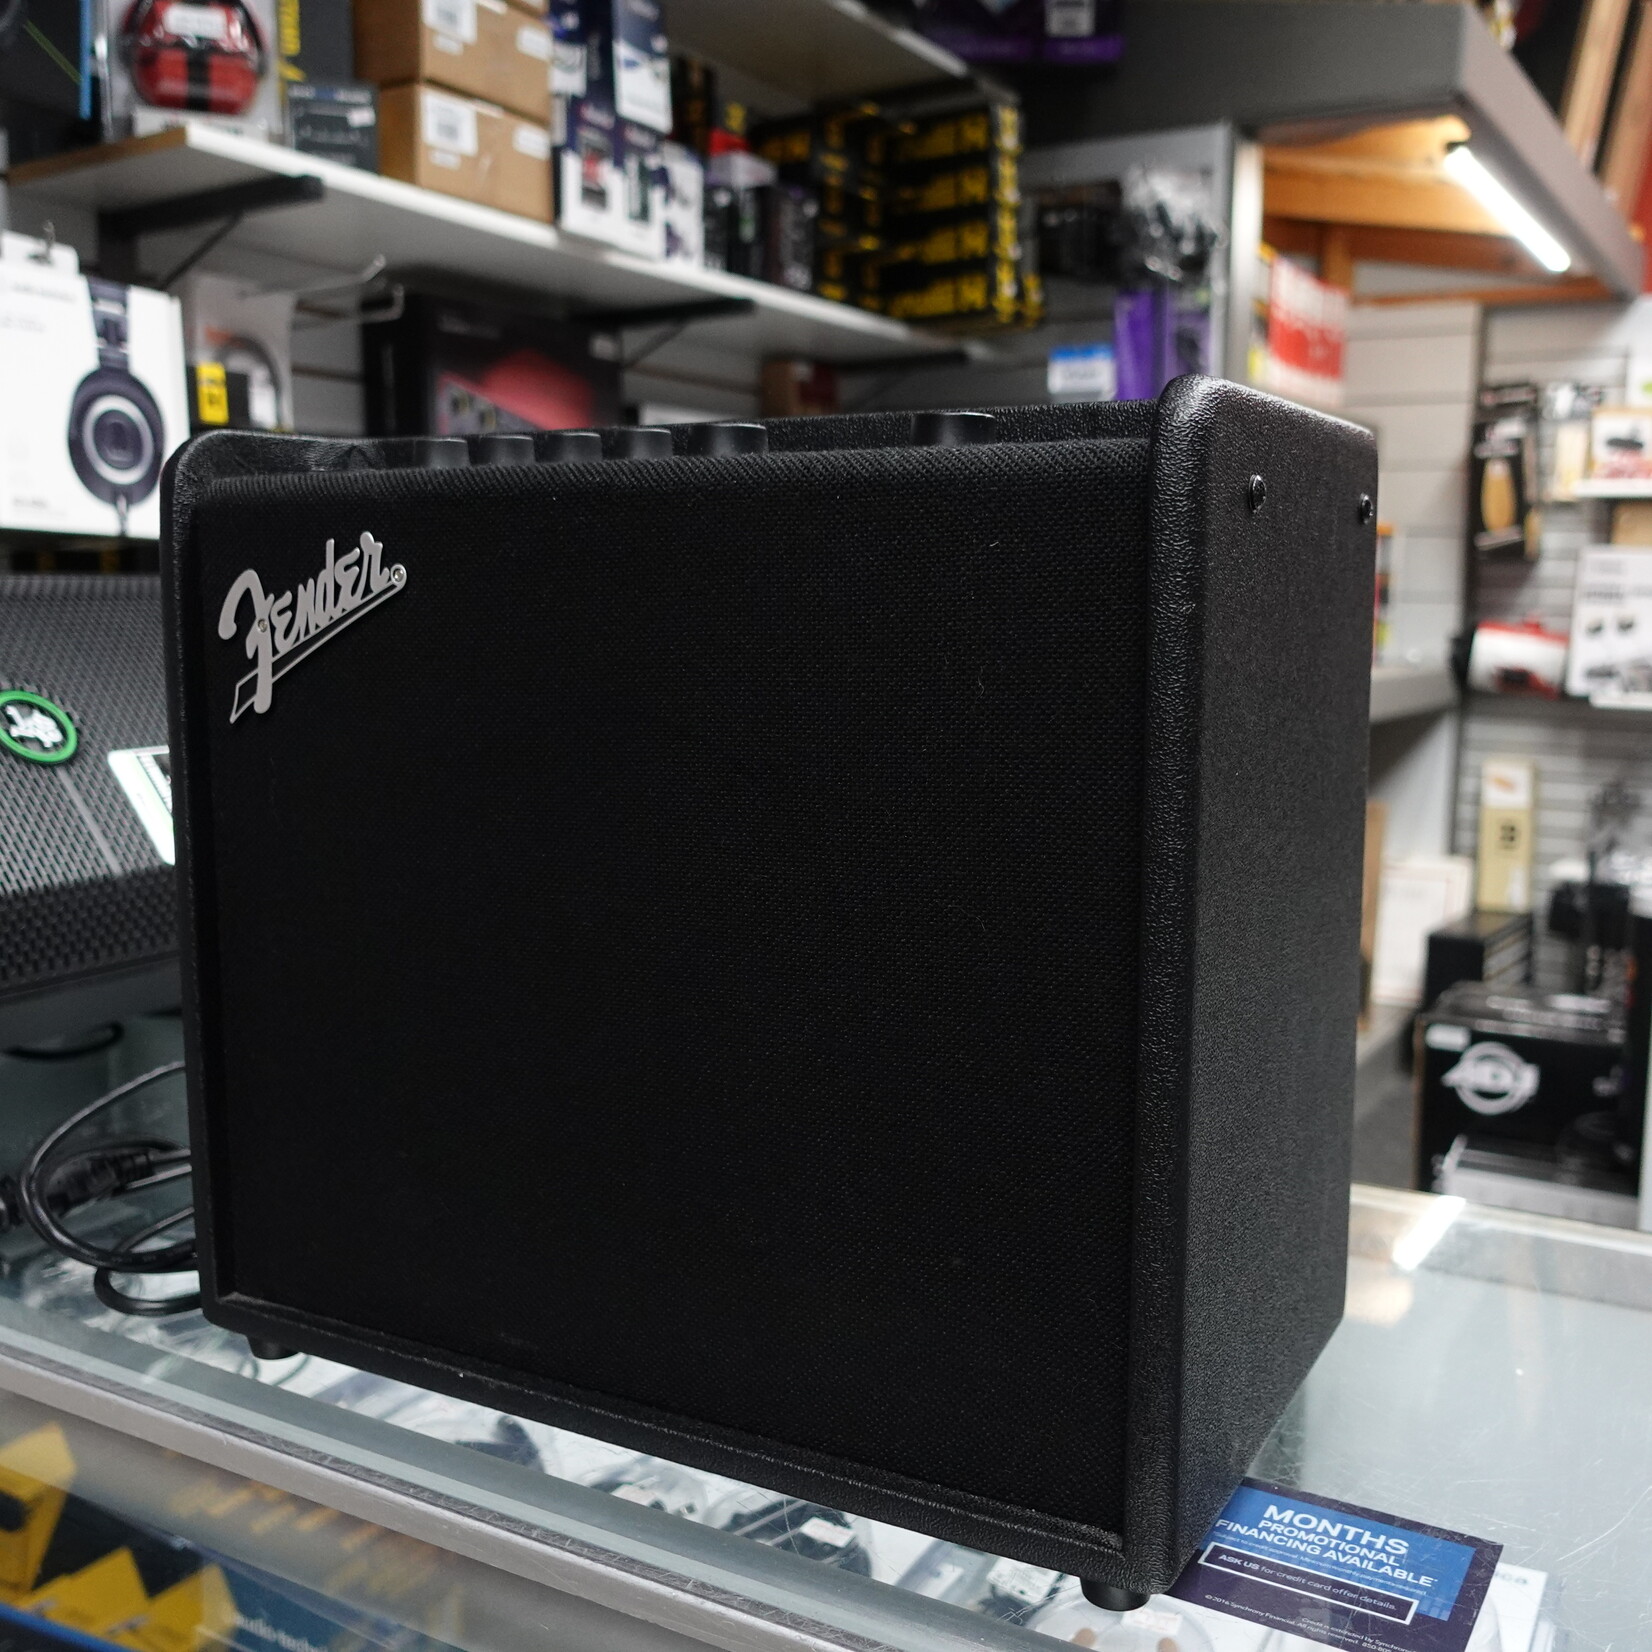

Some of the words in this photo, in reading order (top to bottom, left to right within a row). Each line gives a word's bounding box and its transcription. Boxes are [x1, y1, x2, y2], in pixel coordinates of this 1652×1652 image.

[218, 531, 398, 715] Fender
[1215, 1519, 1322, 1555] FINANCING
[1258, 1520, 1400, 1567] PROMOTIONAL
[1264, 1504, 1409, 1554] MONTHS
[1218, 1554, 1242, 1567] ASK
[1243, 1561, 1261, 1571] US
[1260, 1566, 1277, 1575] for
[1276, 1571, 1306, 1584] credit
[1307, 1580, 1332, 1592] card
[1332, 1586, 1358, 1599] offer
[1359, 1594, 1397, 1611] details.
[1230, 1601, 1265, 1617] Synchrony
[1306, 1624, 1327, 1635] rights
[1302, 1617, 1324, 1629] Credit
[1330, 1626, 1364, 1641] extended
[1364, 1635, 1375, 1644] by
